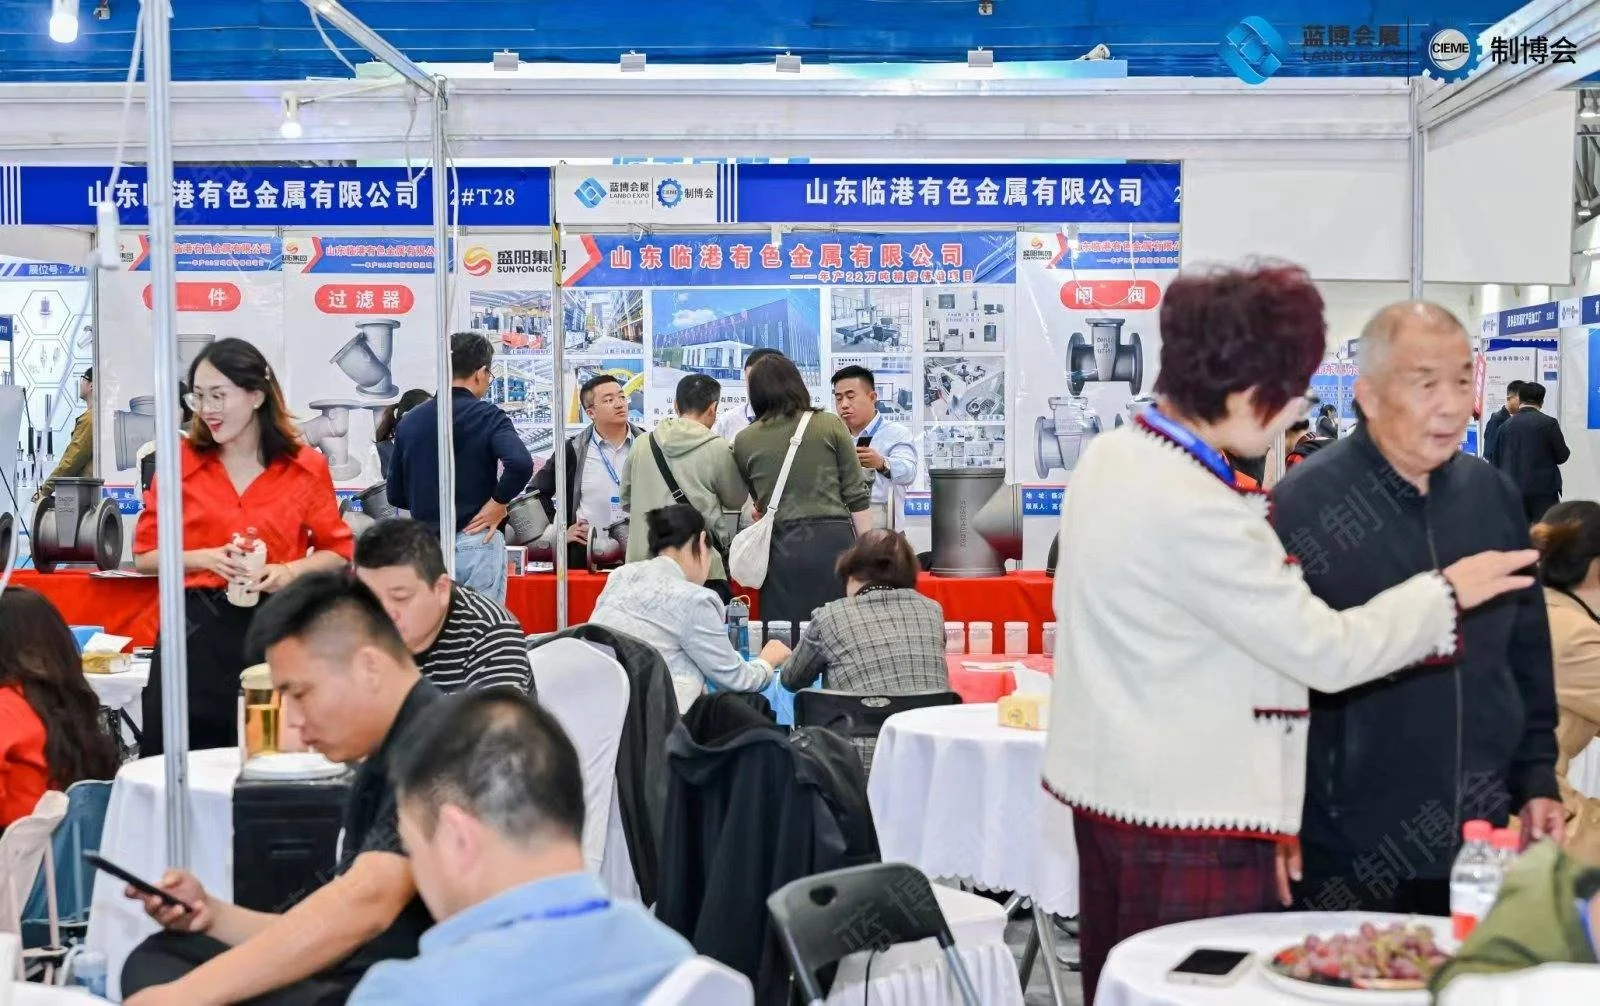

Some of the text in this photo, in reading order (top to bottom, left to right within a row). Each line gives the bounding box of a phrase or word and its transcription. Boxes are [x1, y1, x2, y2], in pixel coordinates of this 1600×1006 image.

[88, 180, 418, 208] 山东港有色金属有限公司
[609, 182, 649, 192] 蓝博会展
[684, 188, 714, 199] 制博会
[806, 177, 1141, 206] 山东临港有色金属有限公司
[610, 244, 964, 269] 山东临港有色金属有限公司
[497, 265, 535, 273] SUNYON
[328, 290, 402, 310] 过滤器
